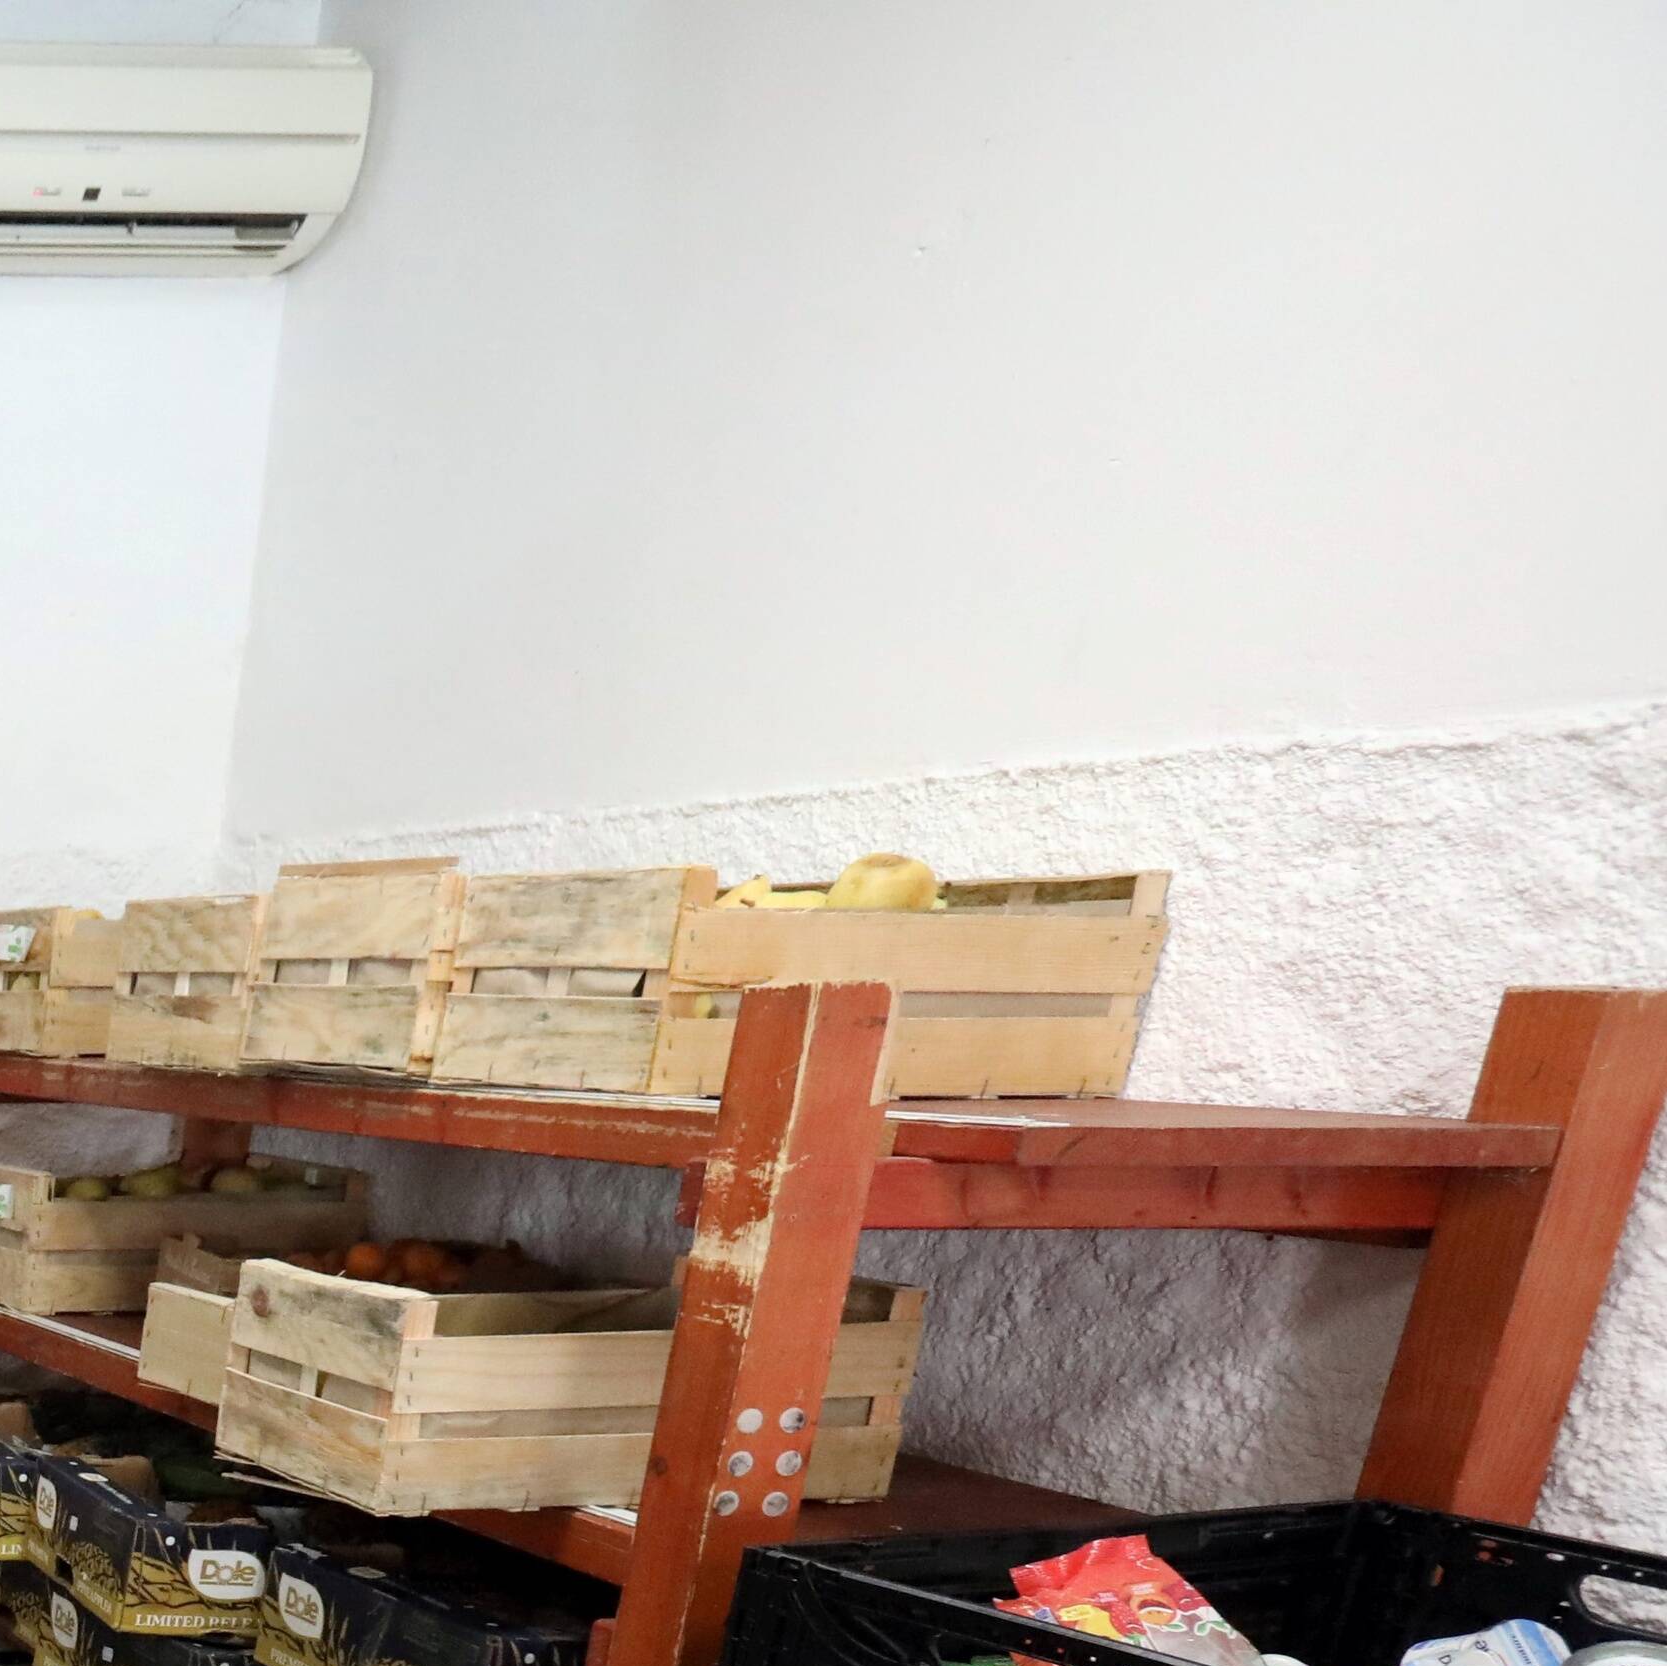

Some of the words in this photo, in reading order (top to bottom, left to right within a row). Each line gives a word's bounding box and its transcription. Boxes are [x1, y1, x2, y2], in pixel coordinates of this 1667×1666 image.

[199, 1558, 257, 1583] Dole
[285, 1584, 320, 1616] Dole
[134, 1613, 205, 1628] LIMITED
